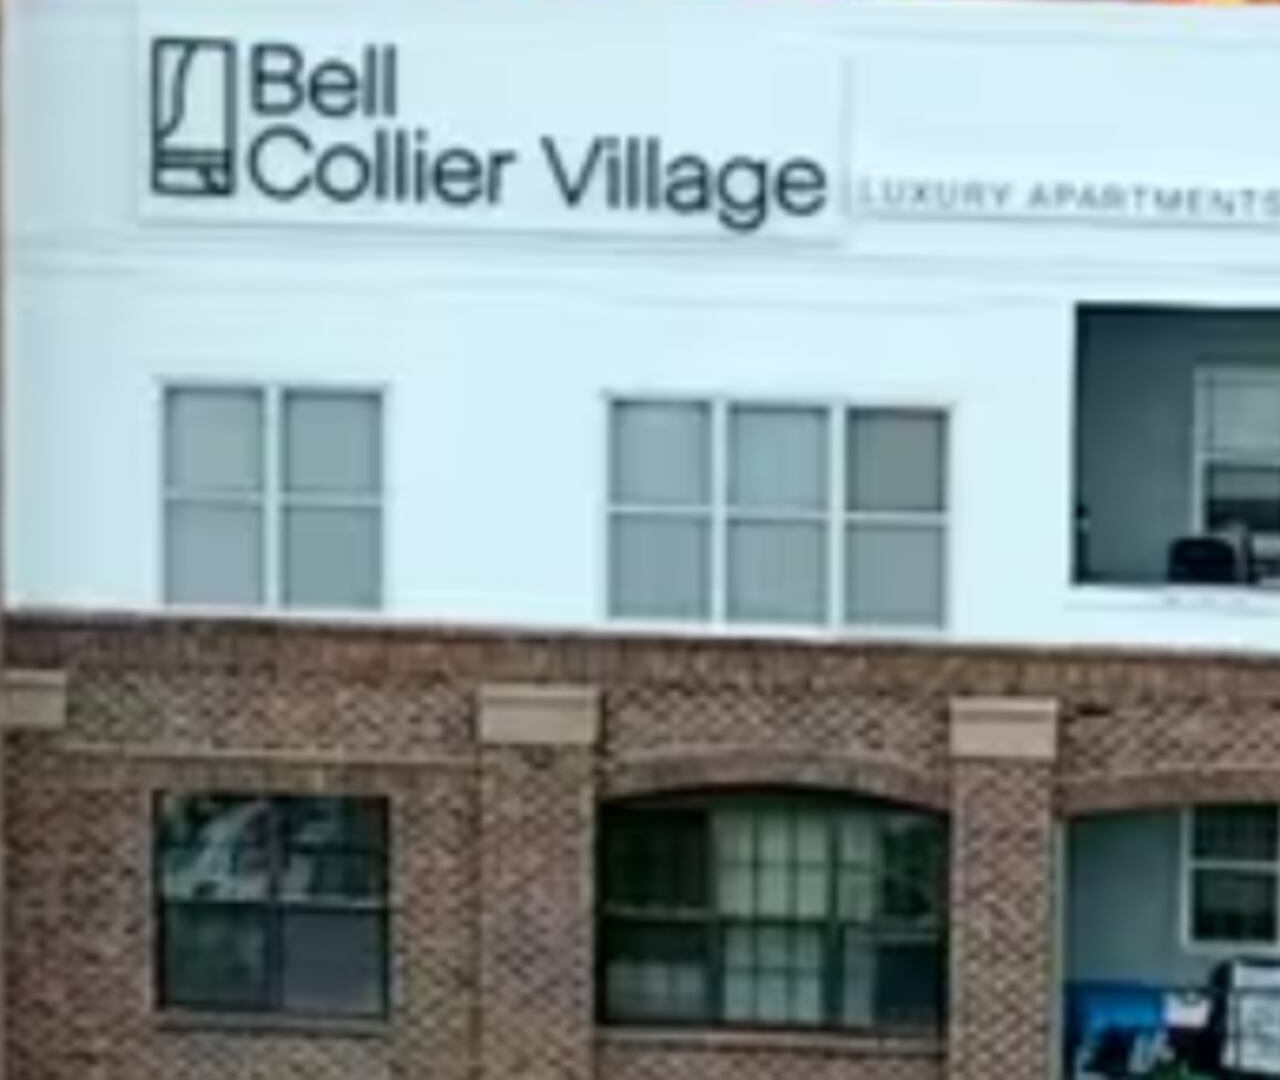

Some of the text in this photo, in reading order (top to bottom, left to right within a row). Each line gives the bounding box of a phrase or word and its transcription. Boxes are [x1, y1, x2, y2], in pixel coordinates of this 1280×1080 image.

[250, 42, 397, 118] Bell
[248, 123, 827, 232] Collier Village
[858, 178, 1012, 211] LUXURY
